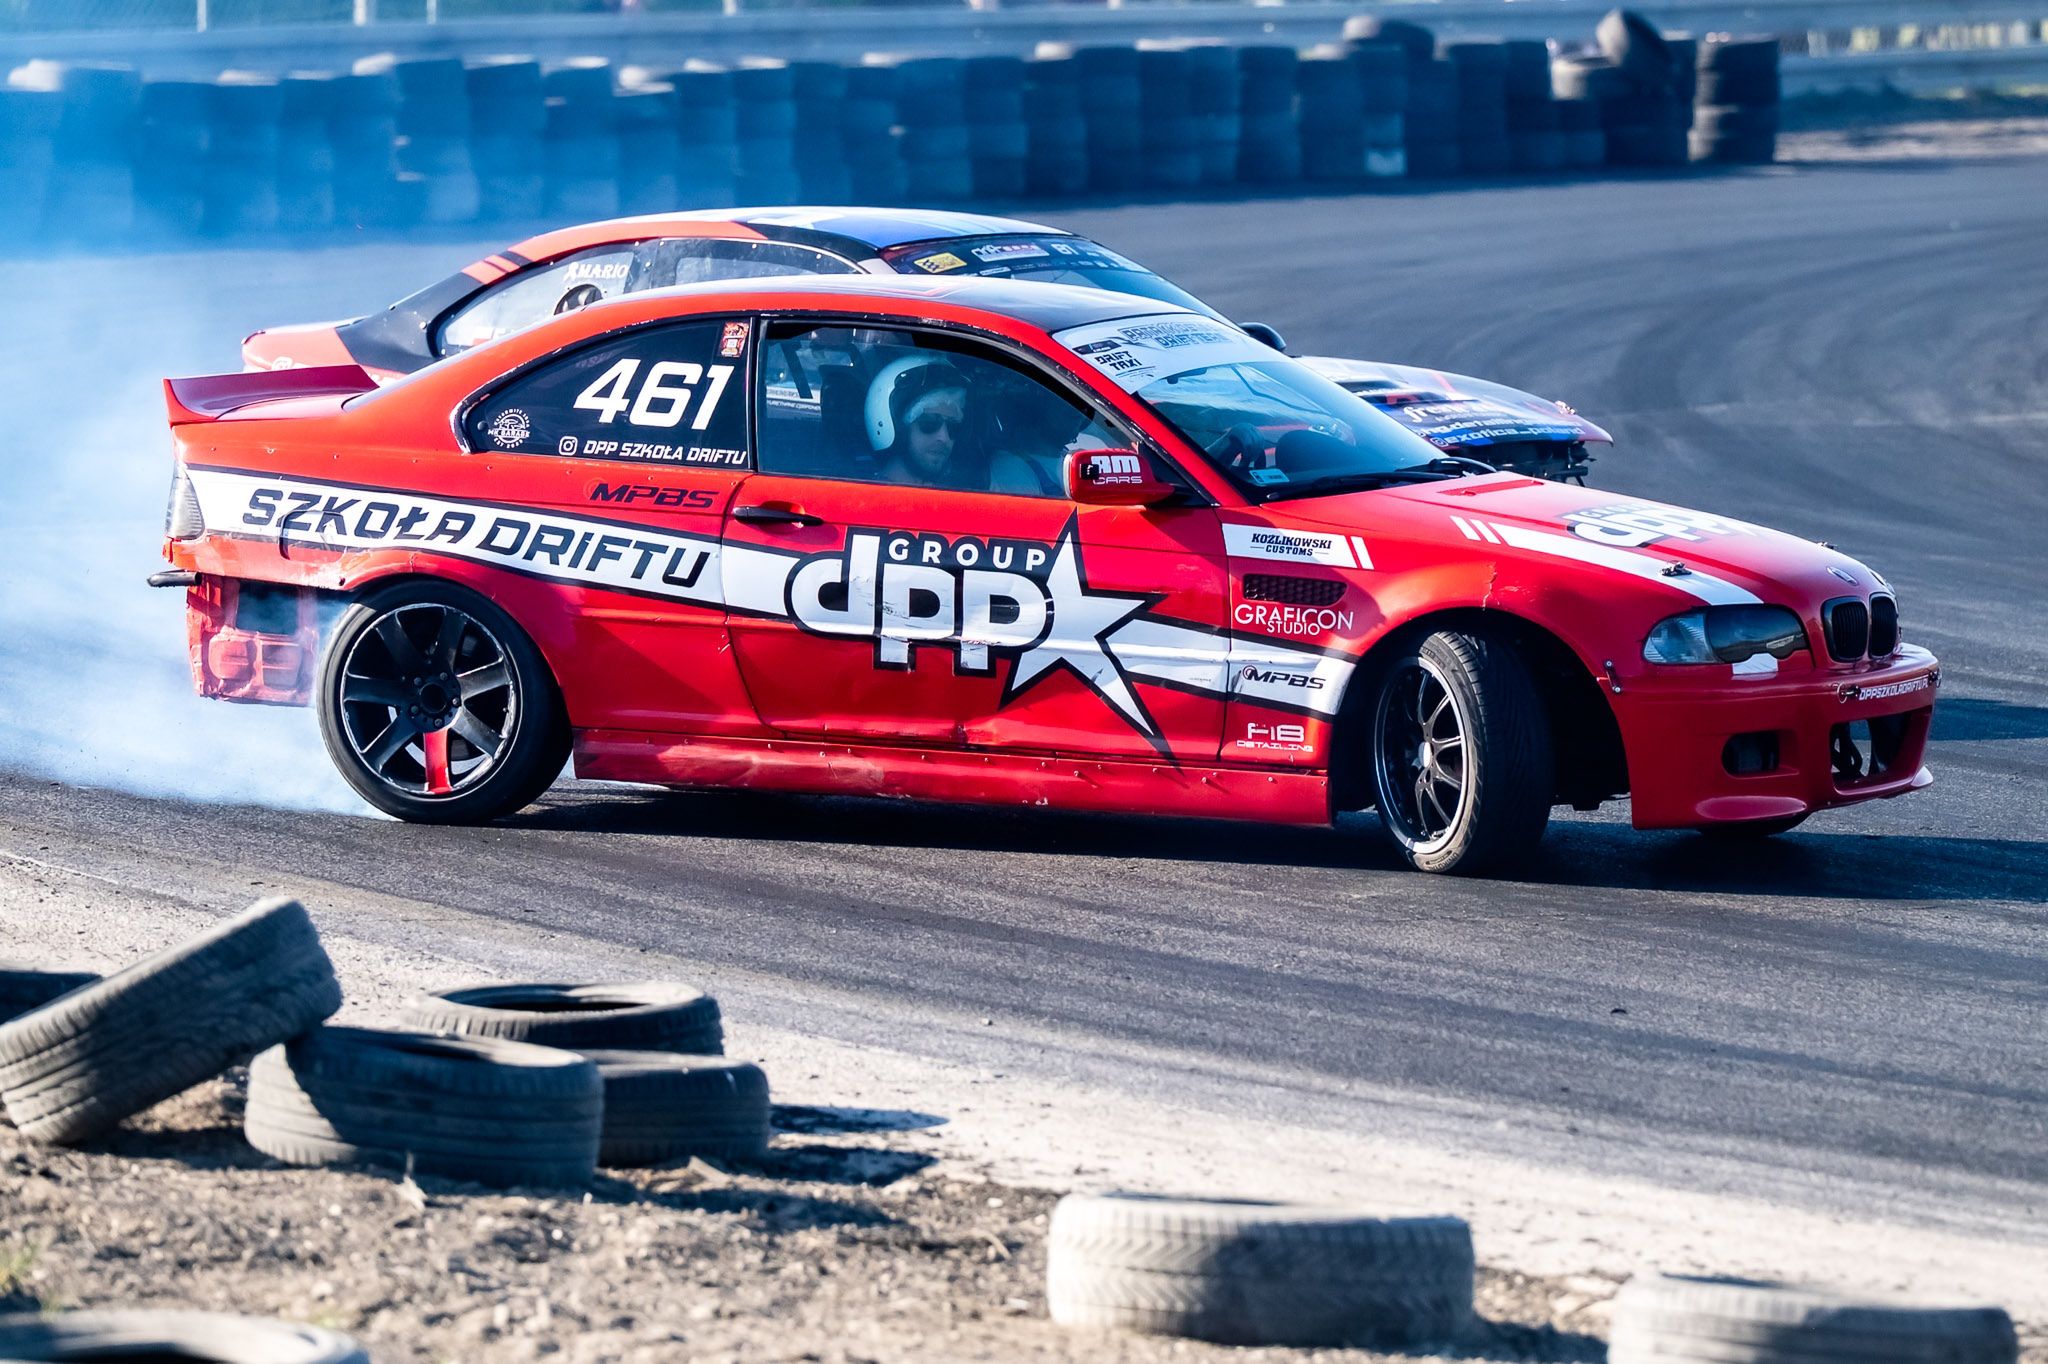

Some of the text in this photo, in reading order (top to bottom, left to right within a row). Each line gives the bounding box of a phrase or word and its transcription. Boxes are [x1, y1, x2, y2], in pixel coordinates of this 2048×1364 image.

[1094, 350, 1134, 365] DRIFT
[1109, 358, 1143, 371] TAXI
[573, 358, 735, 430] 461
[583, 440, 747, 465] DPP SZKOŁA DRIFTU
[1092, 475, 1143, 485] CARS
[589, 483, 720, 508] MPBS
[242, 488, 711, 588] SZKOŁA DRIFTU
[889, 538, 1047, 571] GROUP
[1265, 545, 1313, 556] CUSTOMS
[1234, 603, 1354, 630] GRAFICON
[1266, 620, 1321, 636] STUDIO
[1248, 669, 1327, 690] MPBS
[1236, 739, 1314, 753] DETAILING
